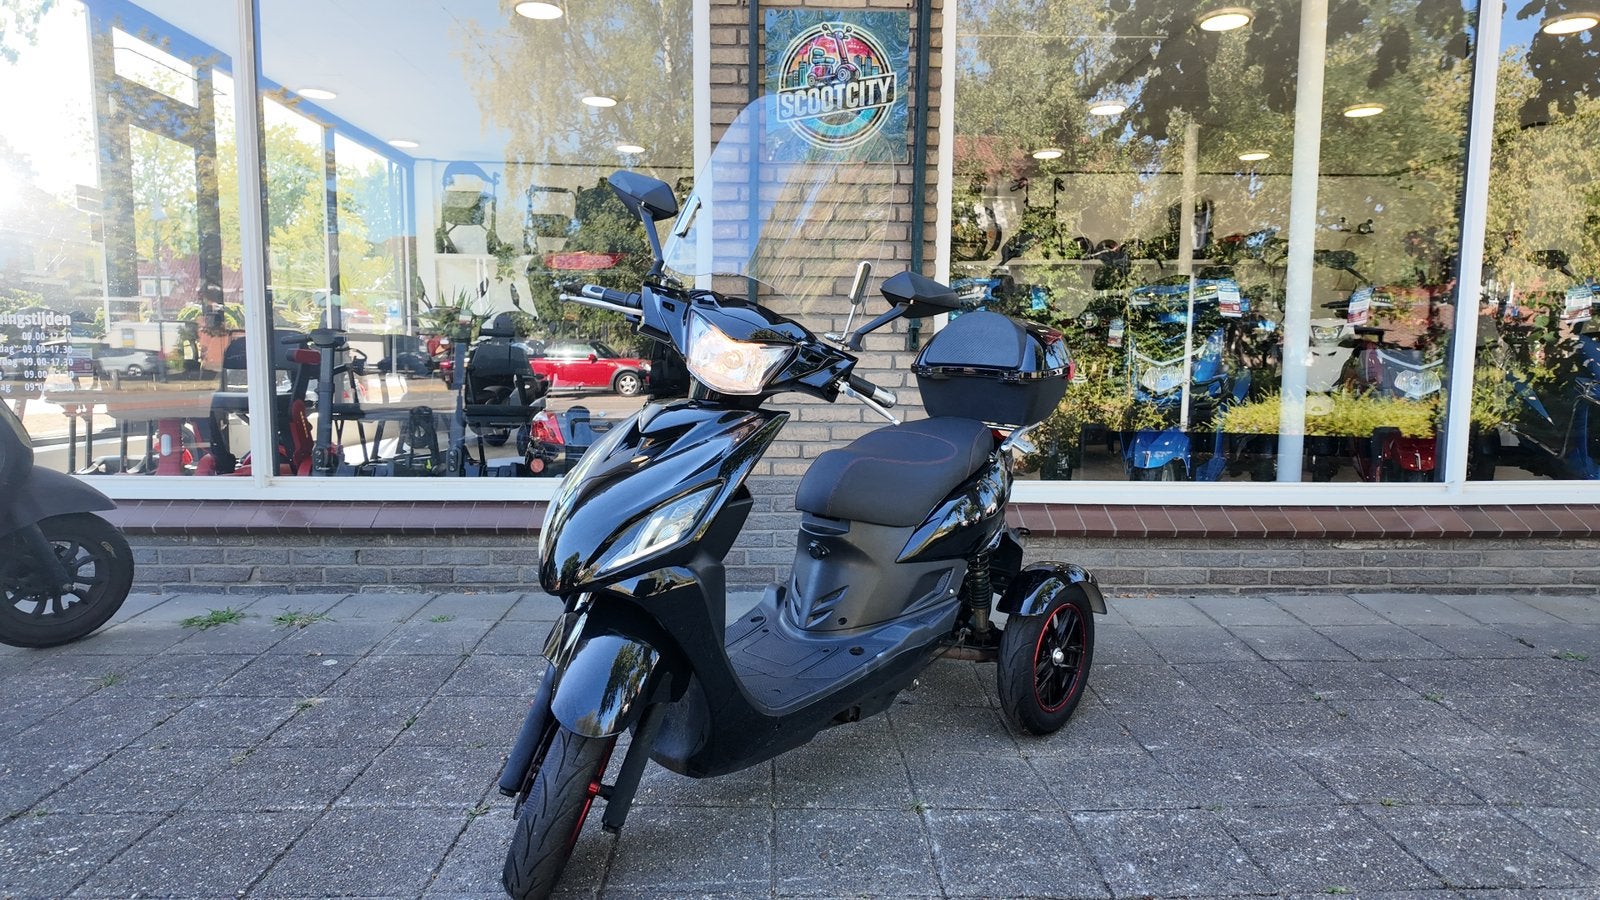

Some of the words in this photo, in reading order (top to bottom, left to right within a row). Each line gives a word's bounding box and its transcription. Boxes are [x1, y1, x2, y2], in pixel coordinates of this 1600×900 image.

[781, 77, 892, 118] SCOOTCITY
[22, 331, 72, 342] 09.00-1730
[22, 344, 73, 354] 09.00-17.30
[23, 357, 74, 367] 09.00-17.30
